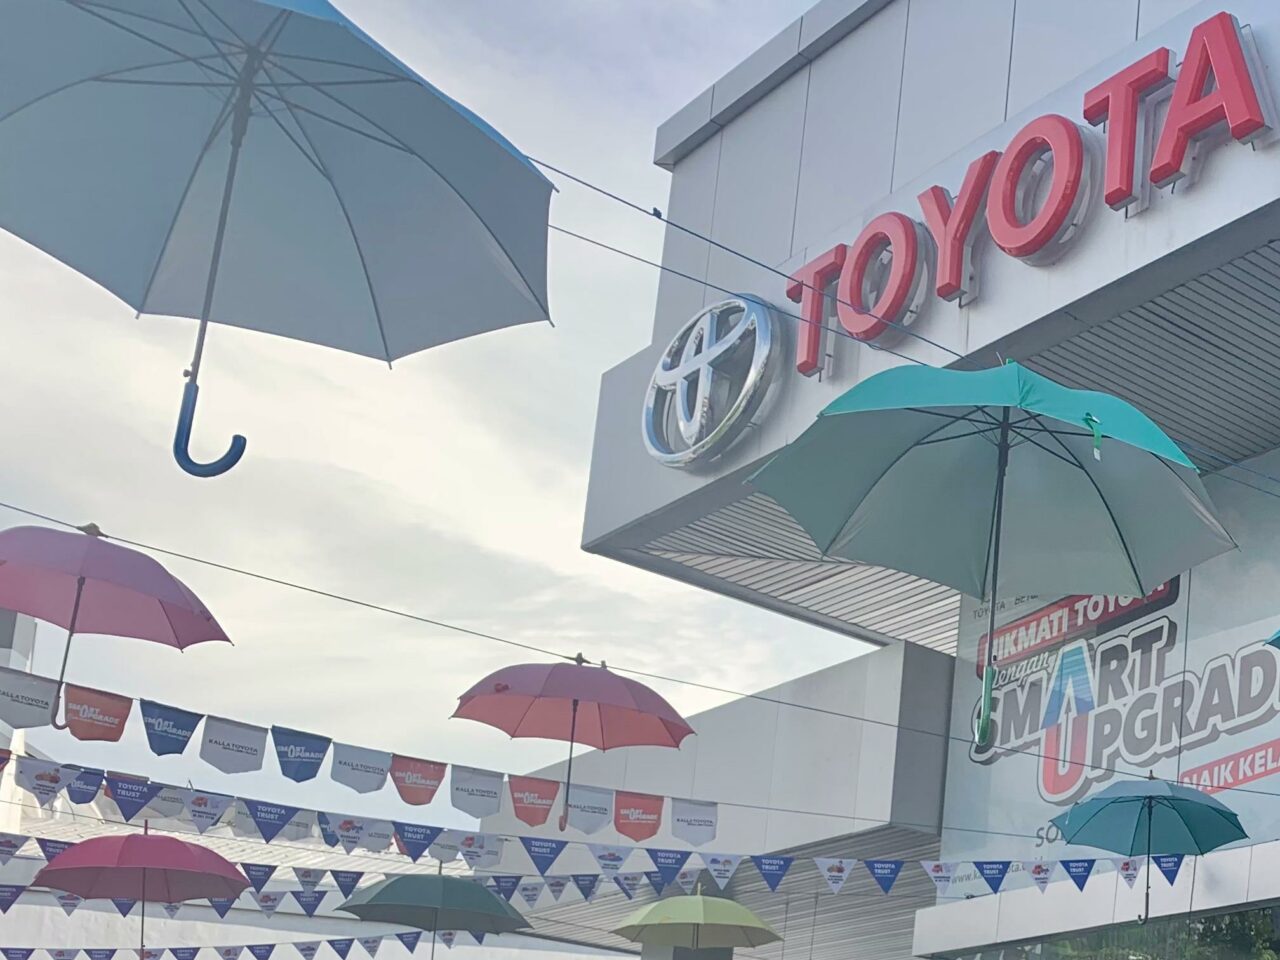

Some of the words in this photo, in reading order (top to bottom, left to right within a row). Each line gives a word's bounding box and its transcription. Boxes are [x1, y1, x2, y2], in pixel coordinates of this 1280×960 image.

[786, 11, 1268, 378] TOYOTA
[973, 600, 1006, 620] TOYTA
[118, 782, 148, 793] TOYOTA
[117, 789, 140, 798] TRUST
[257, 805, 286, 815] TOYOTA
[256, 811, 279, 820] TRUST
[404, 826, 431, 834] TOYOTA
[403, 832, 425, 840] TRUST
